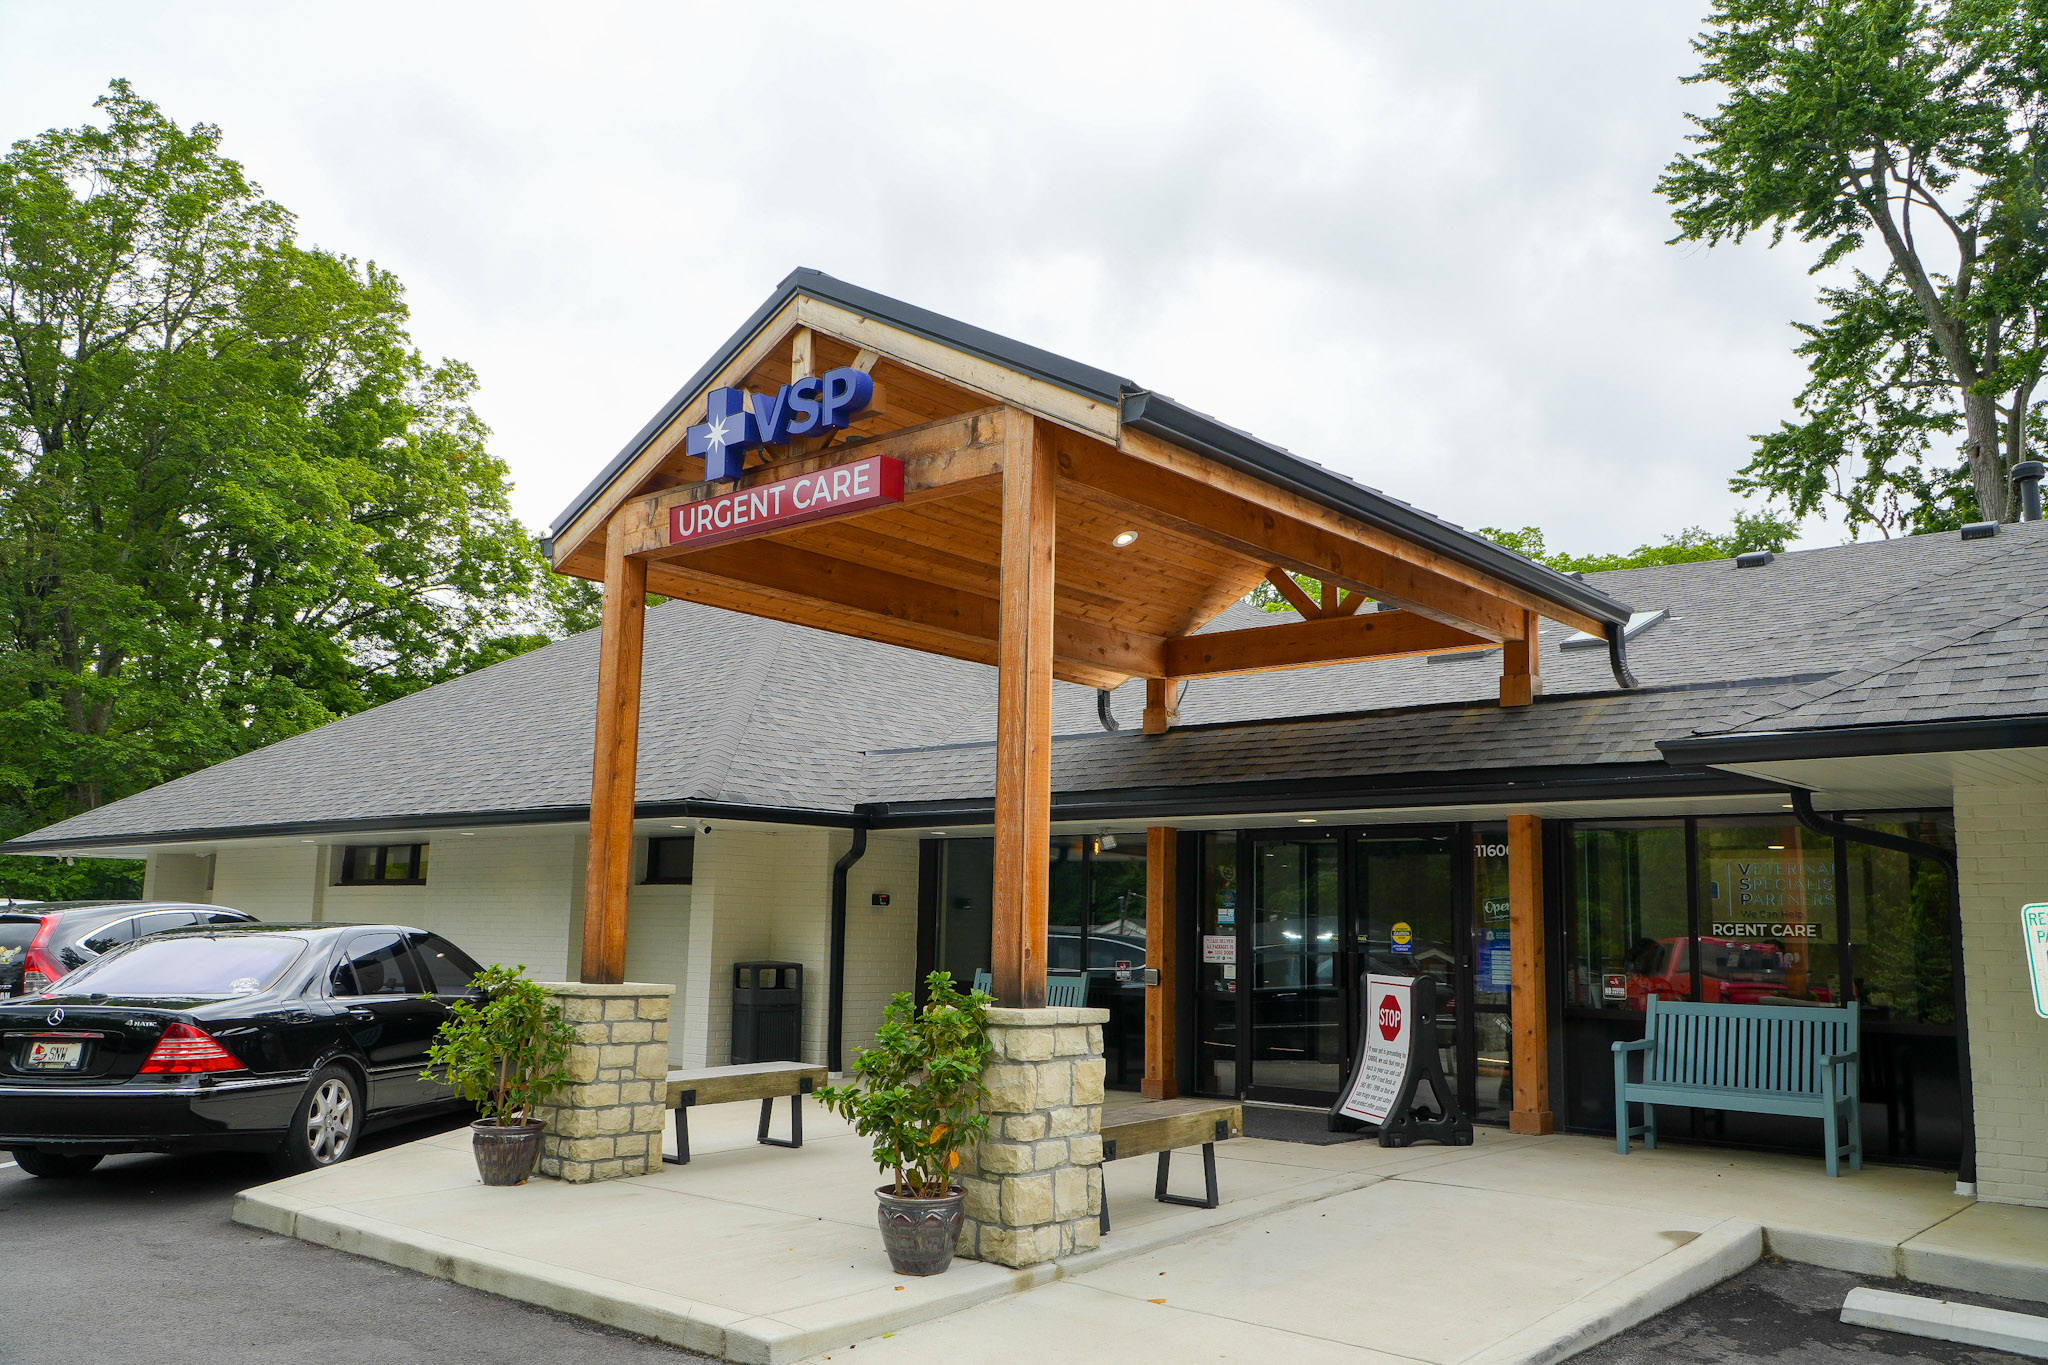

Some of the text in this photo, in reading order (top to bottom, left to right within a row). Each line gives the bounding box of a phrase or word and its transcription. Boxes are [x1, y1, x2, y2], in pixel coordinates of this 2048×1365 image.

[751, 366, 873, 445] VSP
[679, 464, 870, 537] URGENT CARE
[1475, 844, 1509, 857] 1160
[1738, 863, 1835, 875] VETERINA
[1740, 878, 1833, 891] SPECIALIS
[1741, 893, 1835, 906] PARTNERS
[1741, 910, 1757, 918] We
[1760, 910, 1778, 919] Can
[2029, 912, 2048, 926] RE
[1712, 923, 1817, 937] RGENT CARE
[1380, 1008, 1400, 1028] STOP
